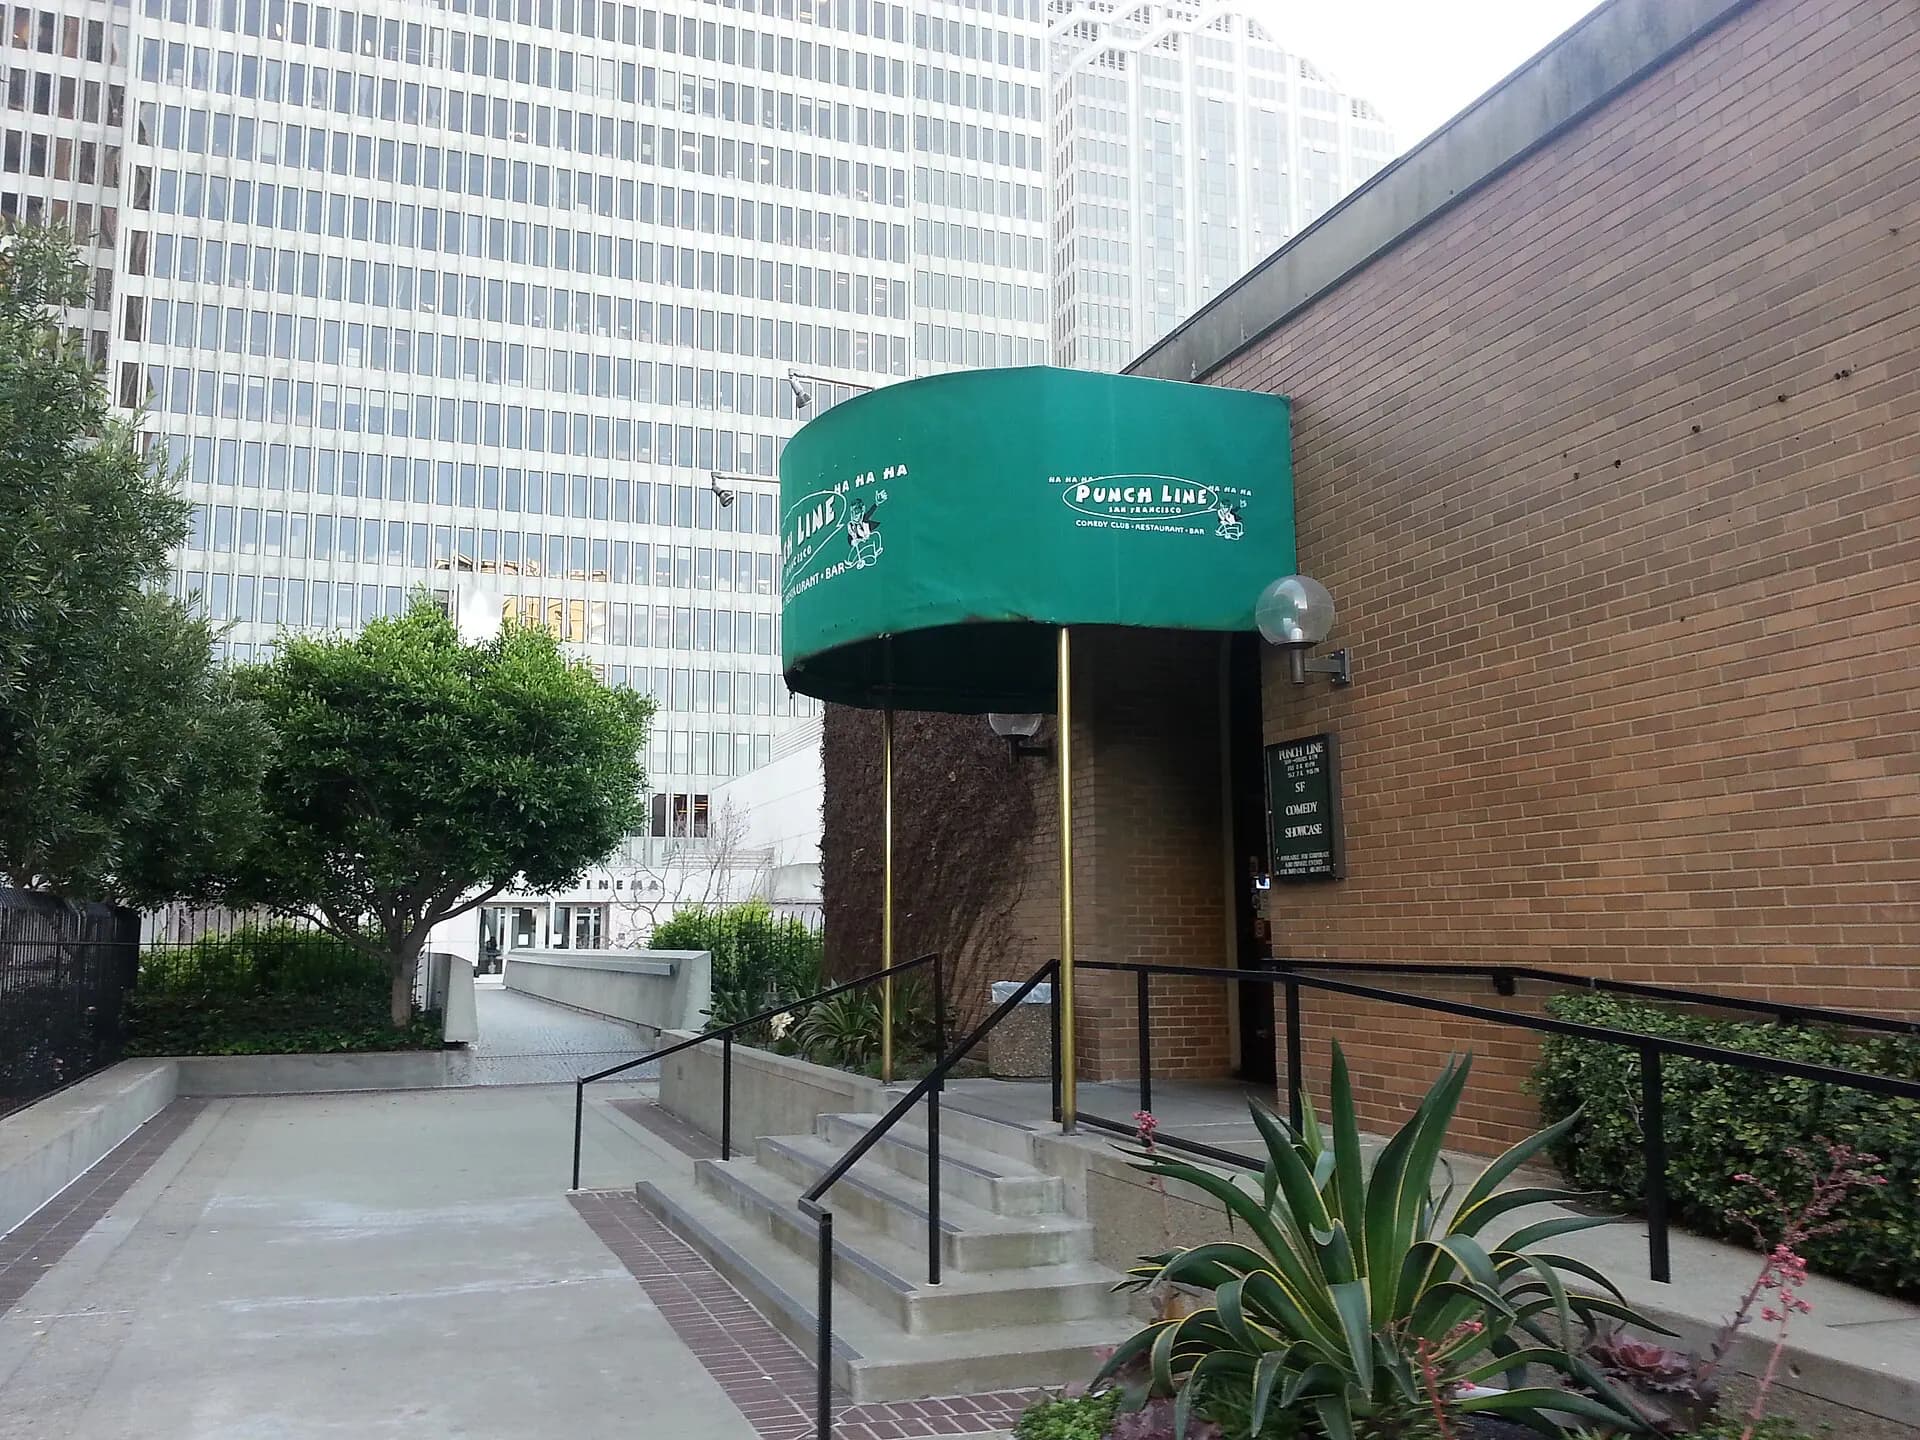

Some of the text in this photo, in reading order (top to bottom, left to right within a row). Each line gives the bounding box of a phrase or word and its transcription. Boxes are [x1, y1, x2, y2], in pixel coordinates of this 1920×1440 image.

[834, 464, 908, 494] HA HA HA
[1075, 484, 1207, 505] PUNCH LINE
[1224, 486, 1237, 494] HA
[1240, 488, 1253, 497] HA
[1130, 506, 1182, 514] FRANCISCO
[797, 495, 836, 546] LINE
[1075, 519, 1205, 535] COMEDY CLUB RESTAURANT BAR
[825, 561, 846, 580] BAR
[1295, 781, 1306, 793] SF
[1285, 801, 1318, 816] COMEDY
[1284, 823, 1323, 838] SHOWCASE
